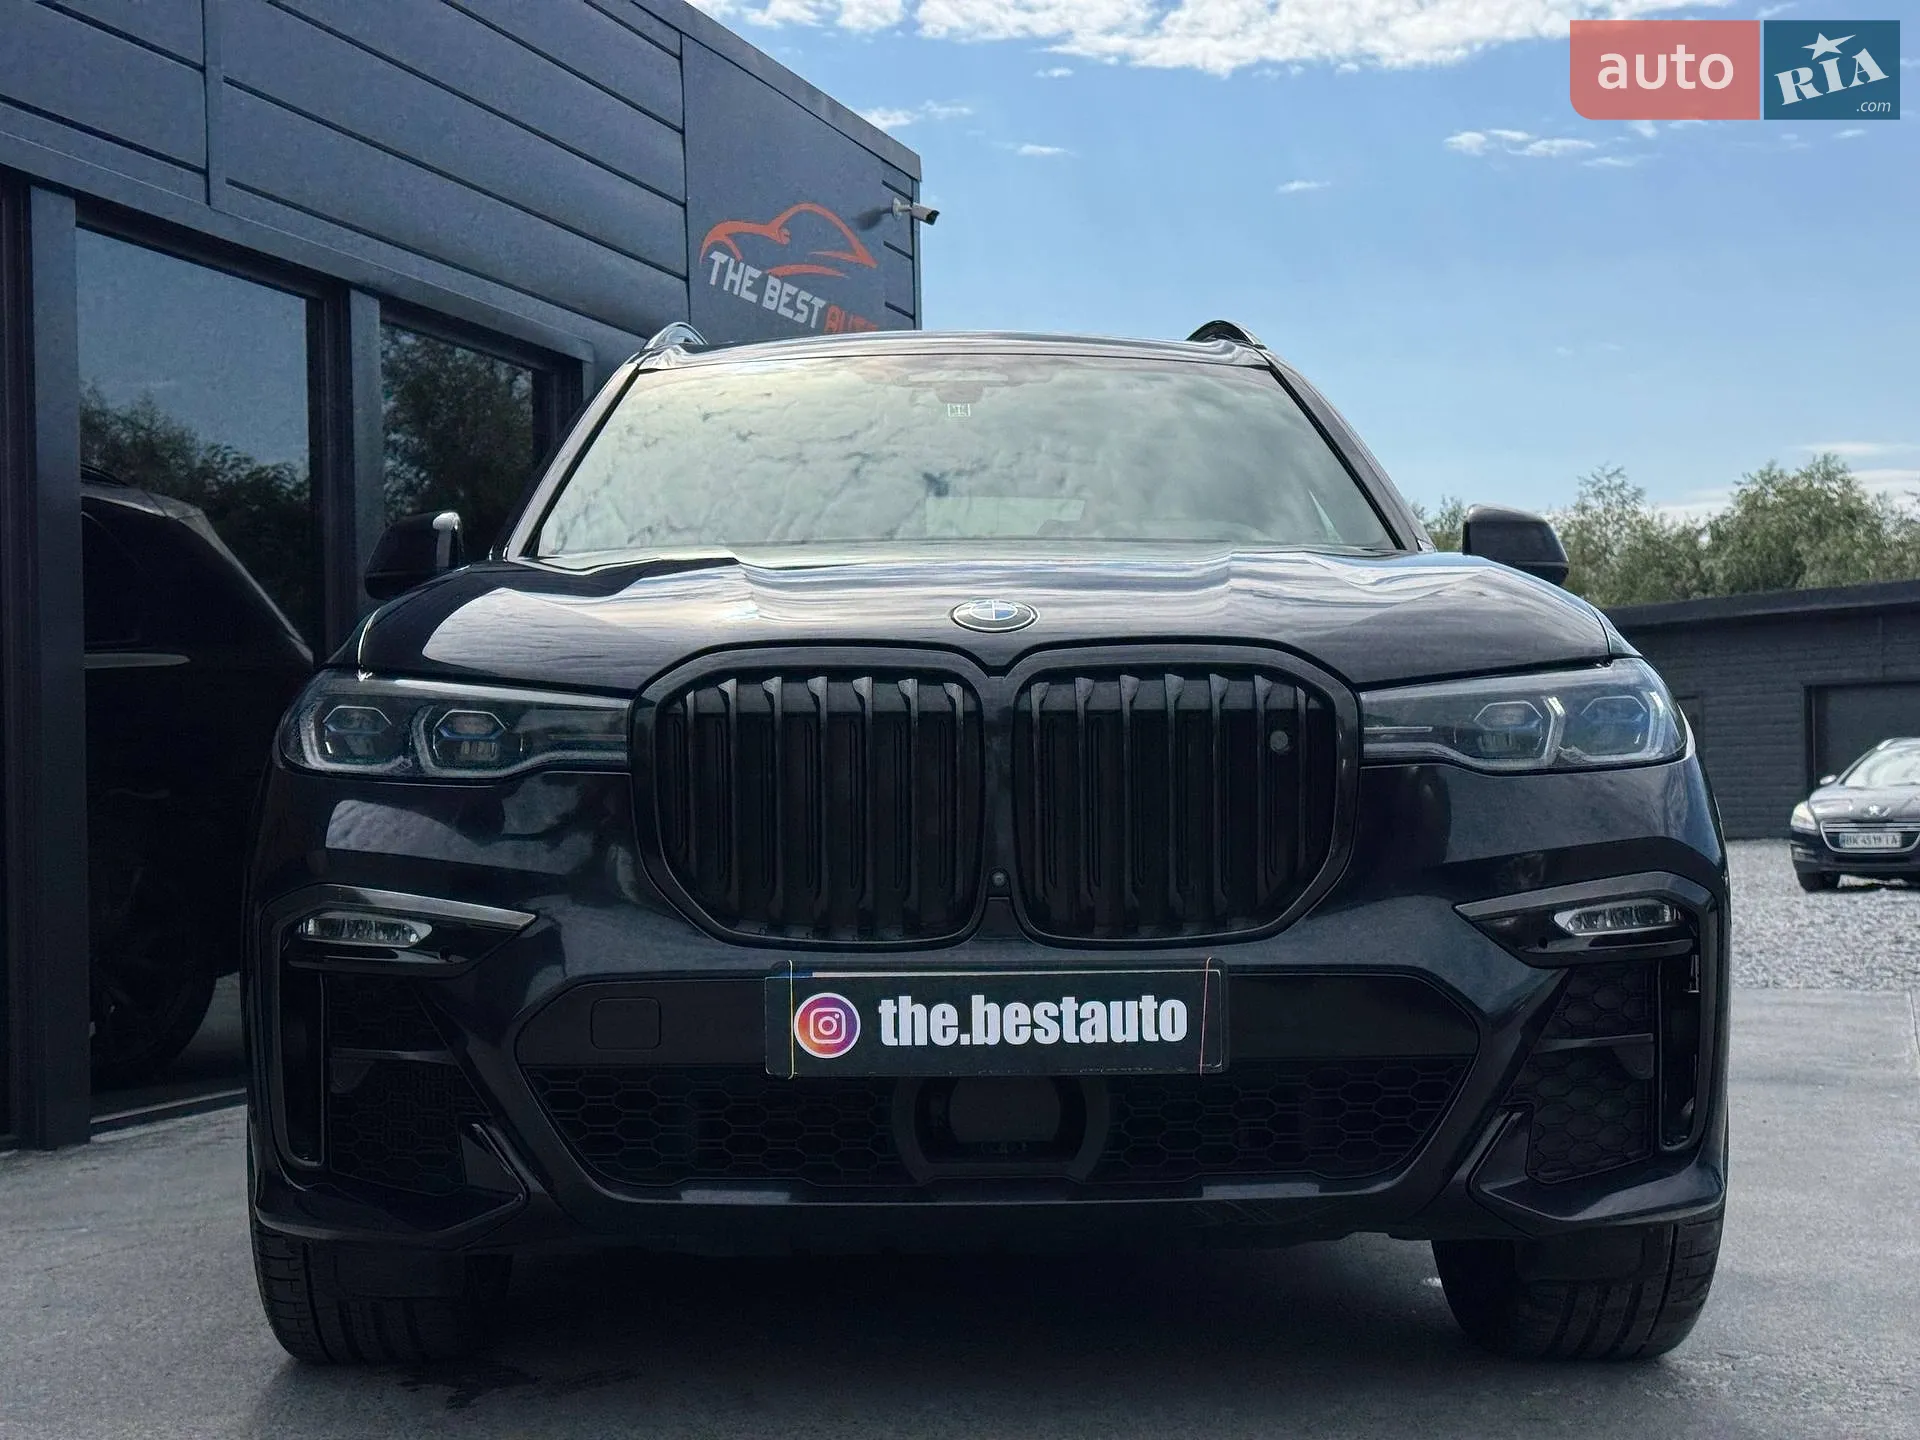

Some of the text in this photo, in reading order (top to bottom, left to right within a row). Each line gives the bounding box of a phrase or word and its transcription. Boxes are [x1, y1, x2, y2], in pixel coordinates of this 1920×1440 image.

[709, 250, 763, 303] THE
[762, 274, 827, 329] BEST
[878, 994, 1188, 1047] the.bestauto
